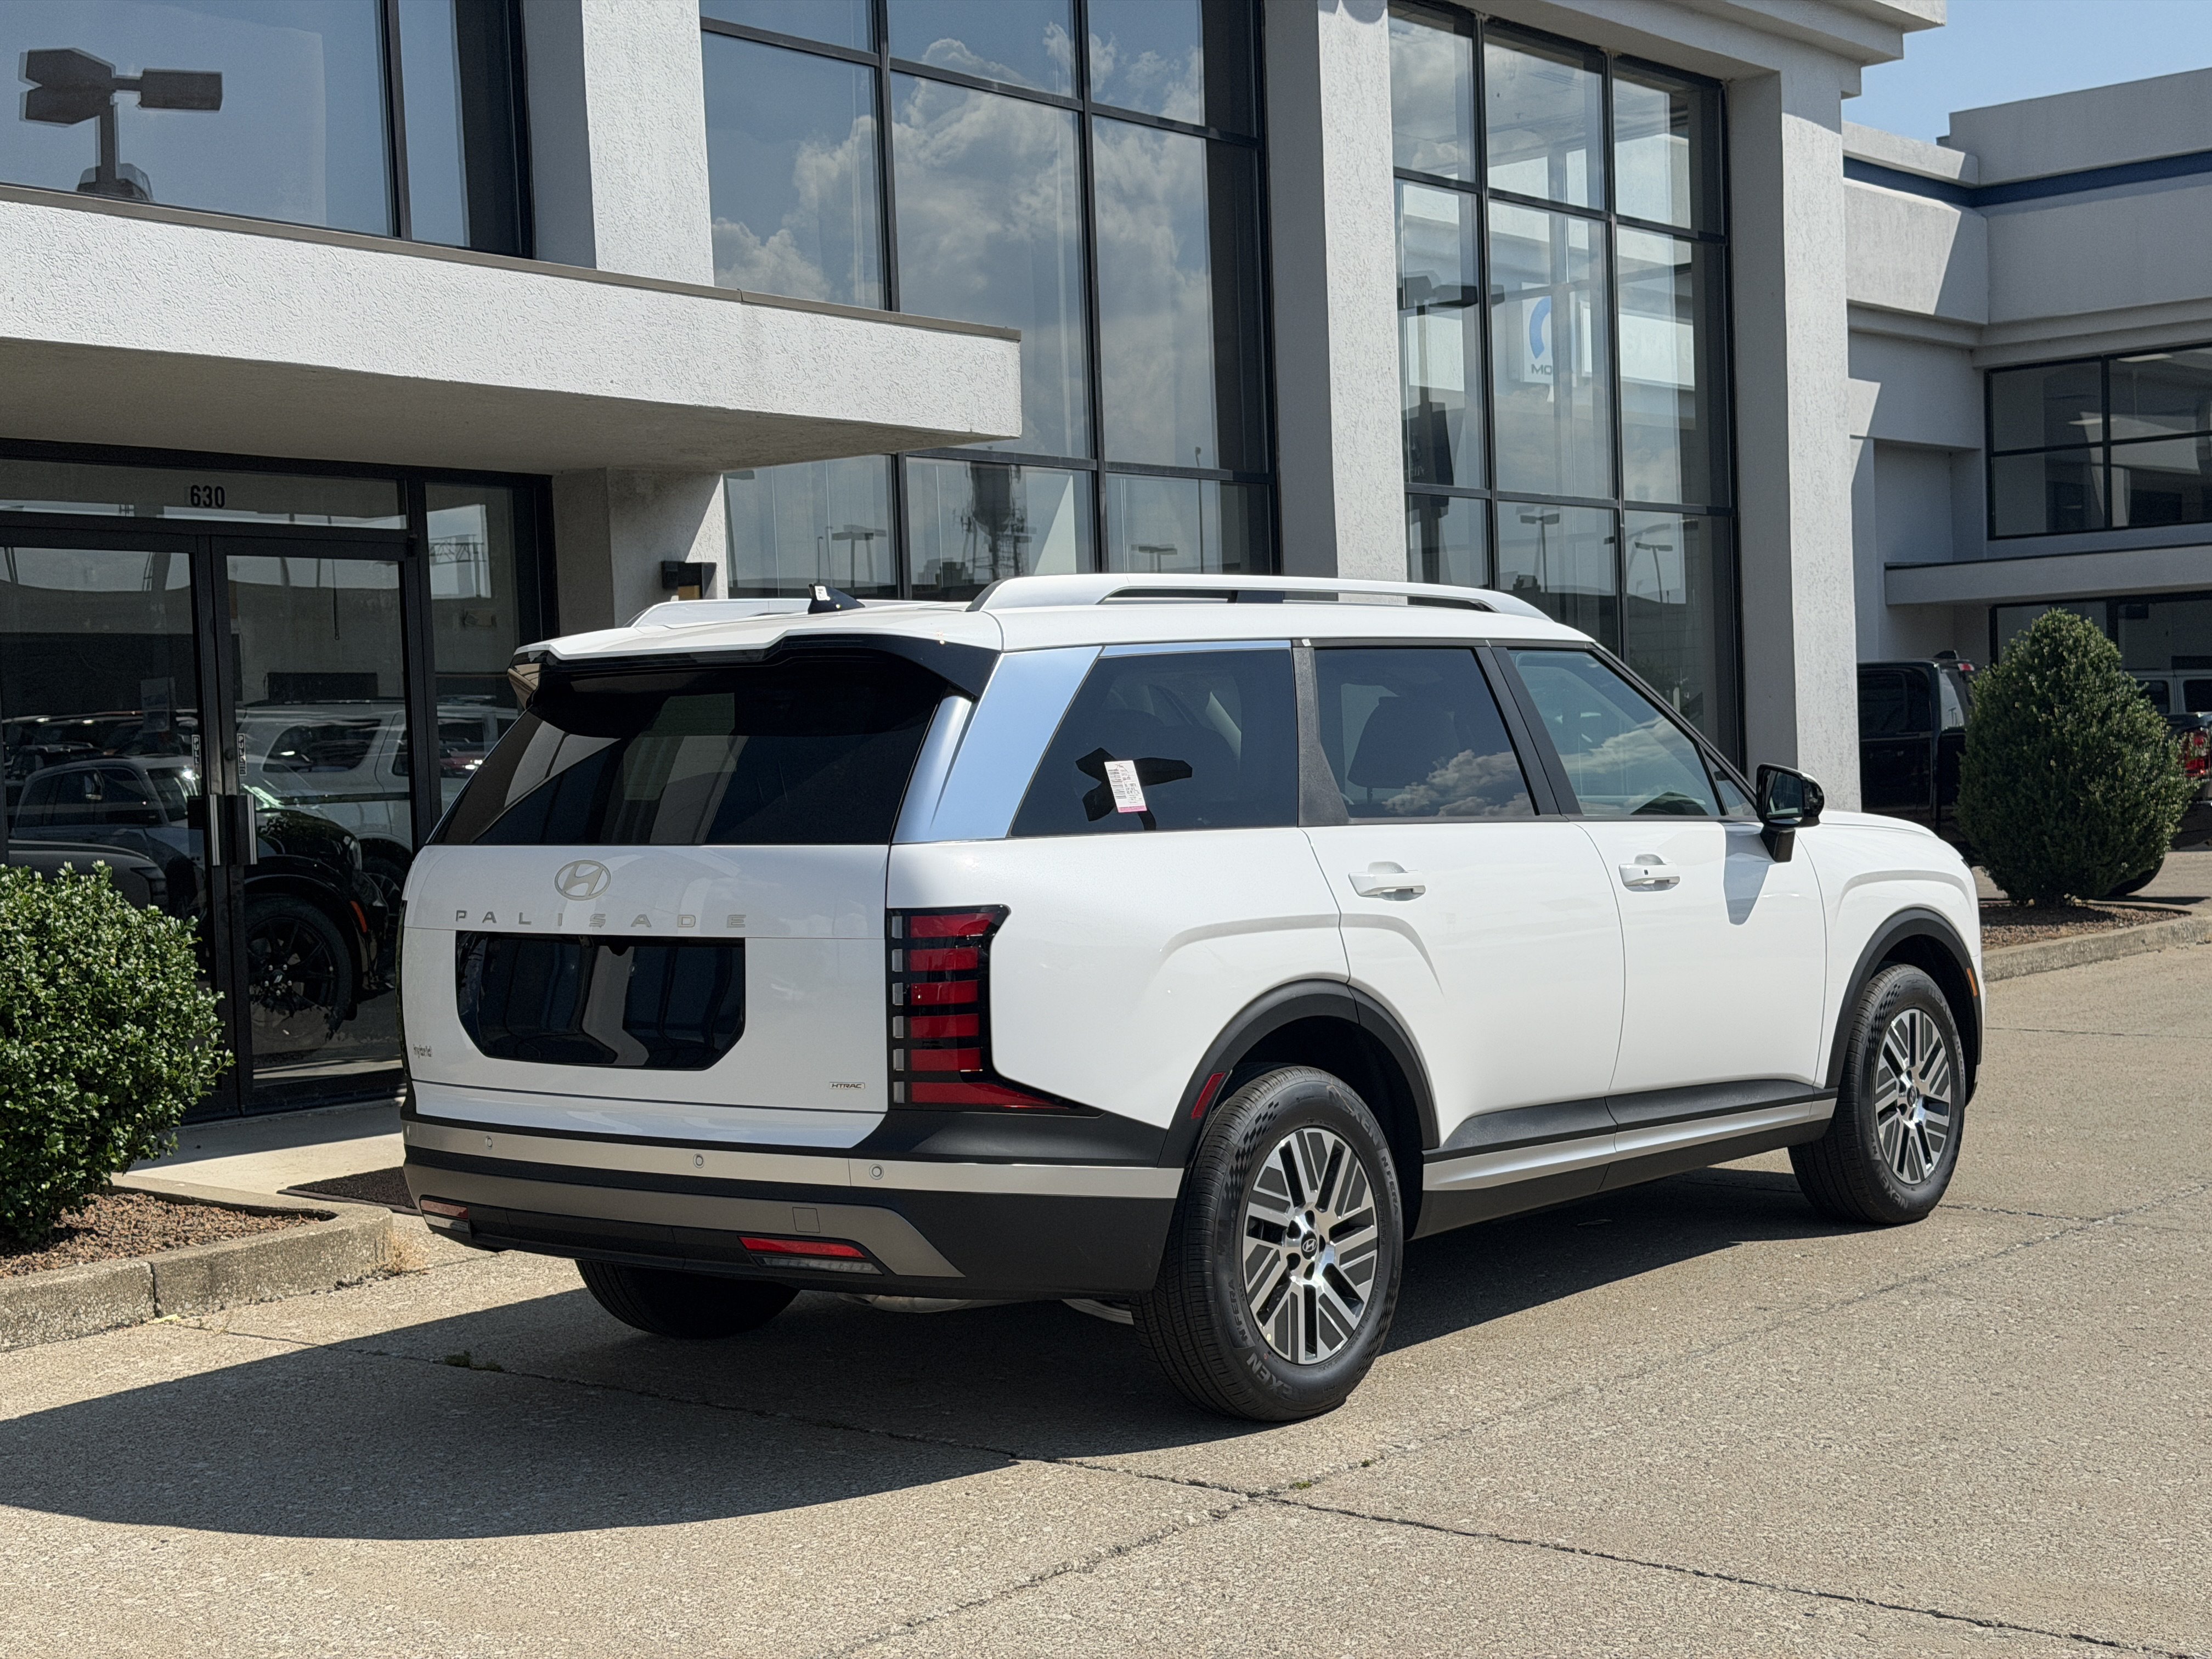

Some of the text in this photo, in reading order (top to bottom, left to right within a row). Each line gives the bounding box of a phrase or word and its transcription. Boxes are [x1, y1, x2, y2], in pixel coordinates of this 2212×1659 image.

[190, 484, 225, 509] 630
[455, 909, 747, 928] PALISADE
[1876, 1165, 1909, 1210] NEXEN
[1246, 1352, 1301, 1400] EXEN
